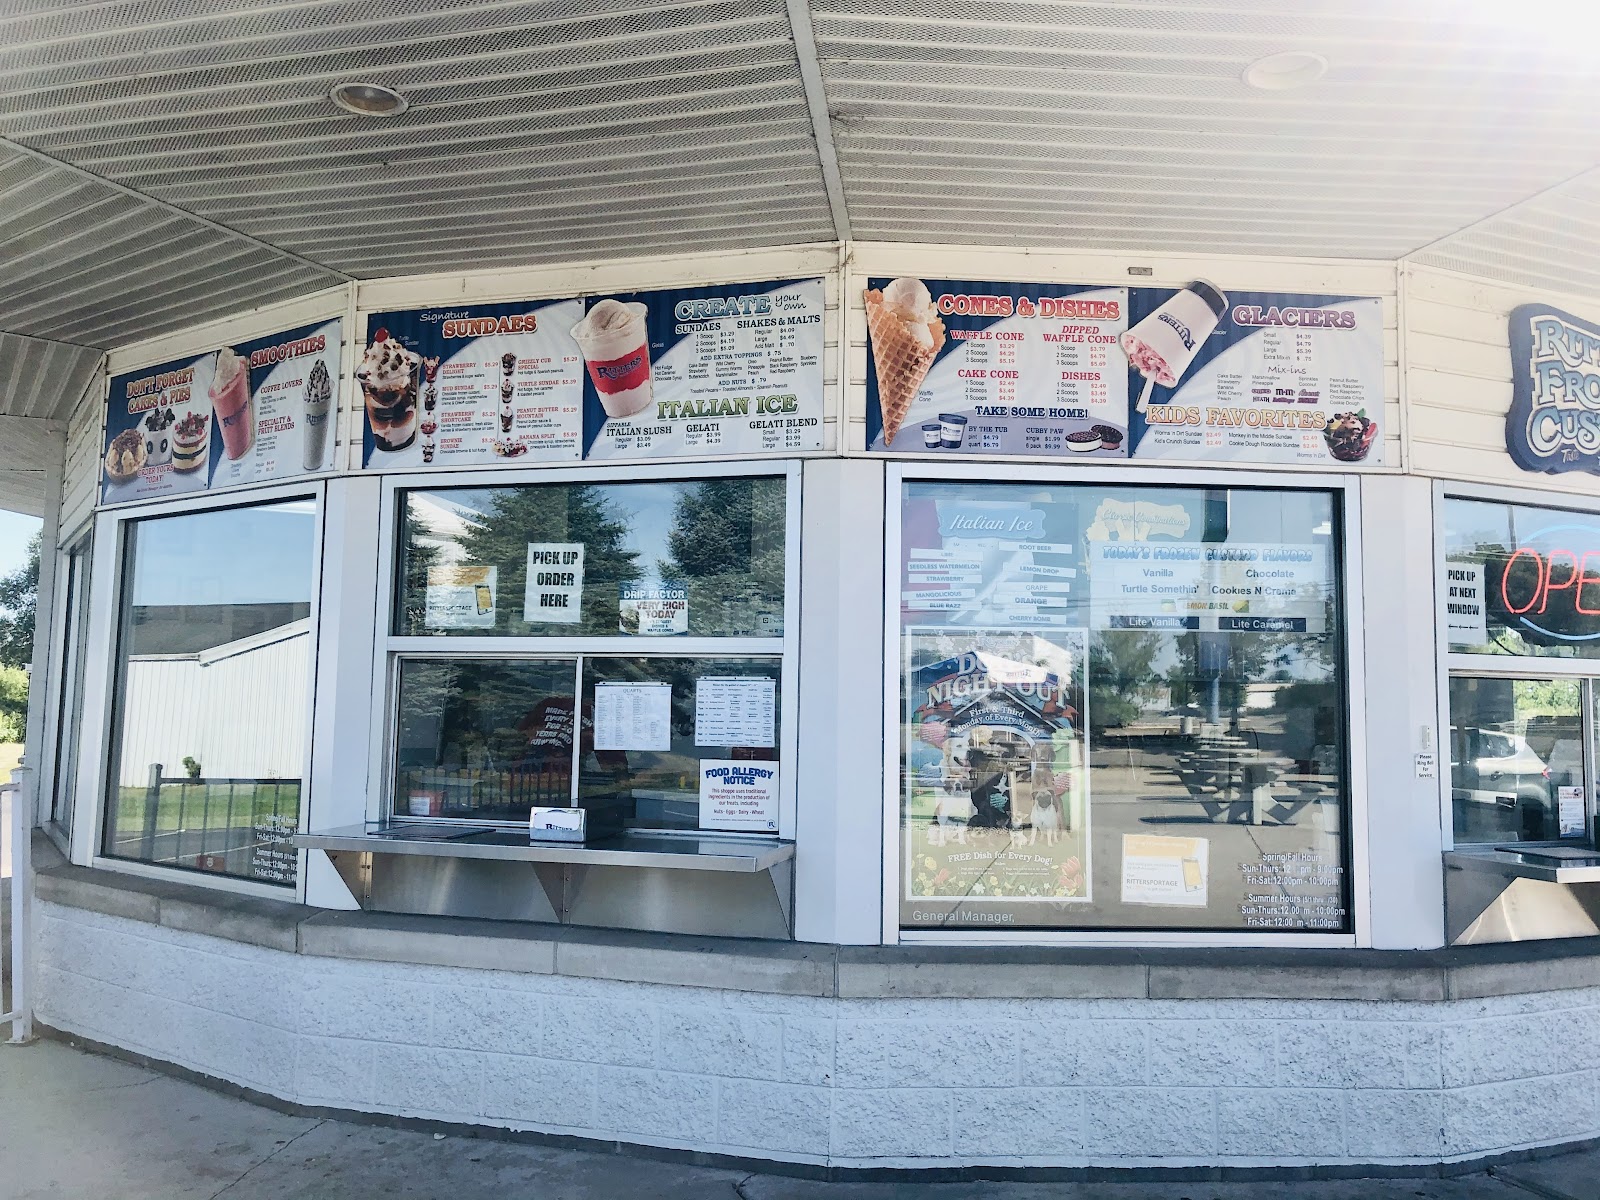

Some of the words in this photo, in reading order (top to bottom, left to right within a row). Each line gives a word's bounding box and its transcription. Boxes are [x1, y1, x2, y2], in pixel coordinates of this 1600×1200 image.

[776, 294, 801, 307] your
[675, 295, 772, 320] CREATE
[938, 294, 1012, 317] CONES
[1018, 298, 1034, 318] &
[1039, 299, 1120, 320] DISHES
[420, 311, 470, 322] Signature
[737, 319, 776, 329] SHAKES
[787, 315, 820, 325] MALTS
[1232, 305, 1356, 329] GLACIERS
[443, 315, 537, 338] SUNDAES
[676, 322, 721, 334] SUNDAES
[1061, 326, 1100, 334] DIPPED
[951, 330, 992, 340] WAFFLE
[996, 332, 1024, 341] CONE
[1043, 334, 1084, 342] WAFFLE
[1088, 335, 1116, 344] CONE
[251, 335, 326, 368] SMOOTHIES
[958, 369, 986, 378] CAKE
[990, 370, 1019, 379] CONE
[1268, 365, 1306, 374] Mix-ins
[127, 378, 155, 396] DON'T
[156, 367, 195, 388] FORGET
[1062, 372, 1100, 381] DISHES
[261, 384, 280, 393] COFFEE
[128, 395, 158, 413] CAKES
[170, 387, 191, 402] PIES
[657, 396, 751, 420] ITALIAN
[756, 394, 799, 415] ICE
[975, 406, 1007, 416] TAKE
[1011, 406, 1045, 417] SOME
[1049, 407, 1088, 418] HOME!
[259, 416, 286, 427] SPECIALTY
[750, 420, 783, 429] GELATI
[787, 418, 817, 427] BLEND
[1146, 405, 1201, 425] KIDS
[1206, 406, 1327, 430] FAVORITES
[258, 427, 273, 435] FRUIT
[274, 422, 294, 432] BLENDS
[607, 428, 641, 436] ITALIAN
[644, 426, 672, 434] SLUSH
[686, 423, 719, 432] GELATI
[1532, 405, 1600, 452] CUS
[950, 514, 1005, 530] Italian
[1009, 516, 1033, 531] Ice
[532, 551, 559, 564] PICK
[562, 551, 578, 565] UP
[1103, 547, 1149, 559] TODAY'S
[1153, 548, 1200, 560] FROZEN
[1205, 548, 1257, 561] CUSTARD
[1263, 550, 1313, 562] FLAVORS
[537, 572, 574, 586] ORDER
[1143, 569, 1173, 577] Vanilla
[1448, 570, 1464, 581] PICK
[1467, 571, 1475, 581] UP
[1502, 548, 1600, 614] OPE
[624, 590, 646, 598] DRIP
[649, 590, 684, 598] FACTOR
[1122, 585, 1147, 593] Turtle
[1151, 585, 1199, 593] Somethin'
[1212, 586, 1251, 594] Cookies
[1450, 587, 1458, 597] AT
[1460, 588, 1476, 599] NEXT
[540, 594, 568, 608] HERE
[663, 601, 684, 609] HIGH
[646, 610, 676, 618] TODAY
[1448, 603, 1479, 615] WINDOW
[1129, 618, 1148, 626] Lite
[1150, 618, 1180, 627] Vanilla
[1231, 621, 1250, 629] Lite
[1253, 621, 1293, 629] Caramel
[969, 708, 989, 717] First
[1002, 706, 1024, 718] Third
[951, 716, 983, 734] Monday
[995, 714, 1016, 724] Every
[1019, 718, 1040, 736] Month
[706, 768, 729, 778] FOOD
[732, 767, 773, 779] ALLERGY
[724, 776, 755, 785] NOTICE
[948, 853, 972, 862] FREE
[1009, 853, 1032, 863] Every
[1034, 855, 1053, 865] Dog!
[1242, 864, 1281, 872] Sun-Thurs:
[1247, 876, 1273, 884] Fri-Sat:
[1274, 876, 1302, 886] 12:00pm
[1309, 877, 1339, 886] 10:00pm
[1248, 894, 1277, 902] Summer
[1280, 894, 1300, 902] Hours
[913, 911, 959, 921] General
[962, 912, 1015, 923] Manager,
[1242, 906, 1280, 914] Sun-Thurs:
[1316, 907, 1345, 916] 10:00pm
[1248, 918, 1273, 926] Fri-Sat:
